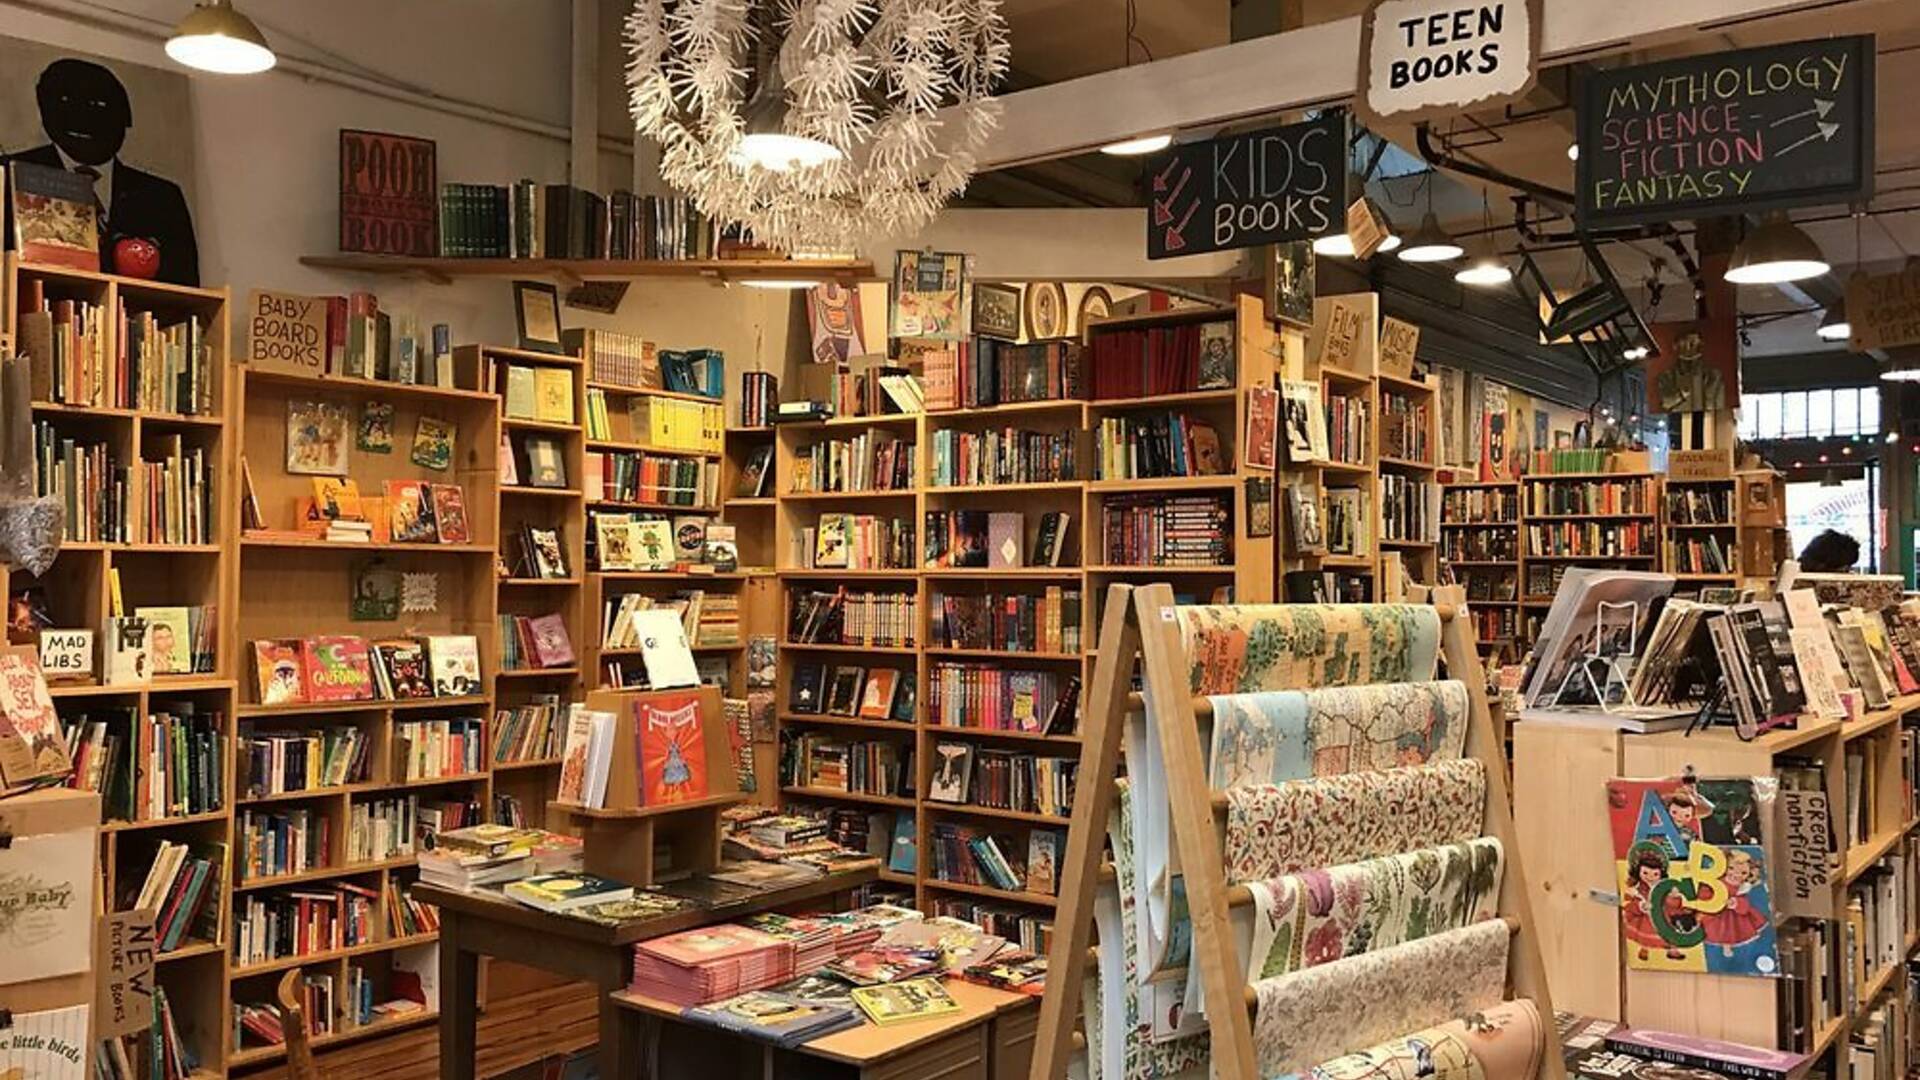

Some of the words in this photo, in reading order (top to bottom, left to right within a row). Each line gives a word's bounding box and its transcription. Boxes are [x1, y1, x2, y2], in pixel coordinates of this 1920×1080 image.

[1399, 4, 1504, 47] TEEN
[1390, 44, 1499, 89] BOOKS
[1605, 53, 1848, 118] MYTHOLOGY
[344, 135, 434, 198] POOH
[1213, 128, 1328, 200] KIDS
[1620, 130, 1765, 180] FICTION
[1595, 169, 1752, 209] FANTASY
[344, 216, 434, 257] BOOK
[1213, 195, 1331, 246] BOOKS
[258, 294, 312, 321] BABY
[1331, 304, 1360, 341] FILM
[253, 316, 319, 346] BOARD
[1381, 320, 1417, 355] MUSIC
[253, 338, 320, 367] BOOKS
[42, 654, 83, 668] LIBS
[47, 635, 86, 651] MAD
[25, 888, 71, 907] Baby
[110, 920, 125, 972] PICTURE
[126, 925, 154, 998] NEW
[12, 1034, 45, 1050] little
[47, 1037, 81, 1065] birds
